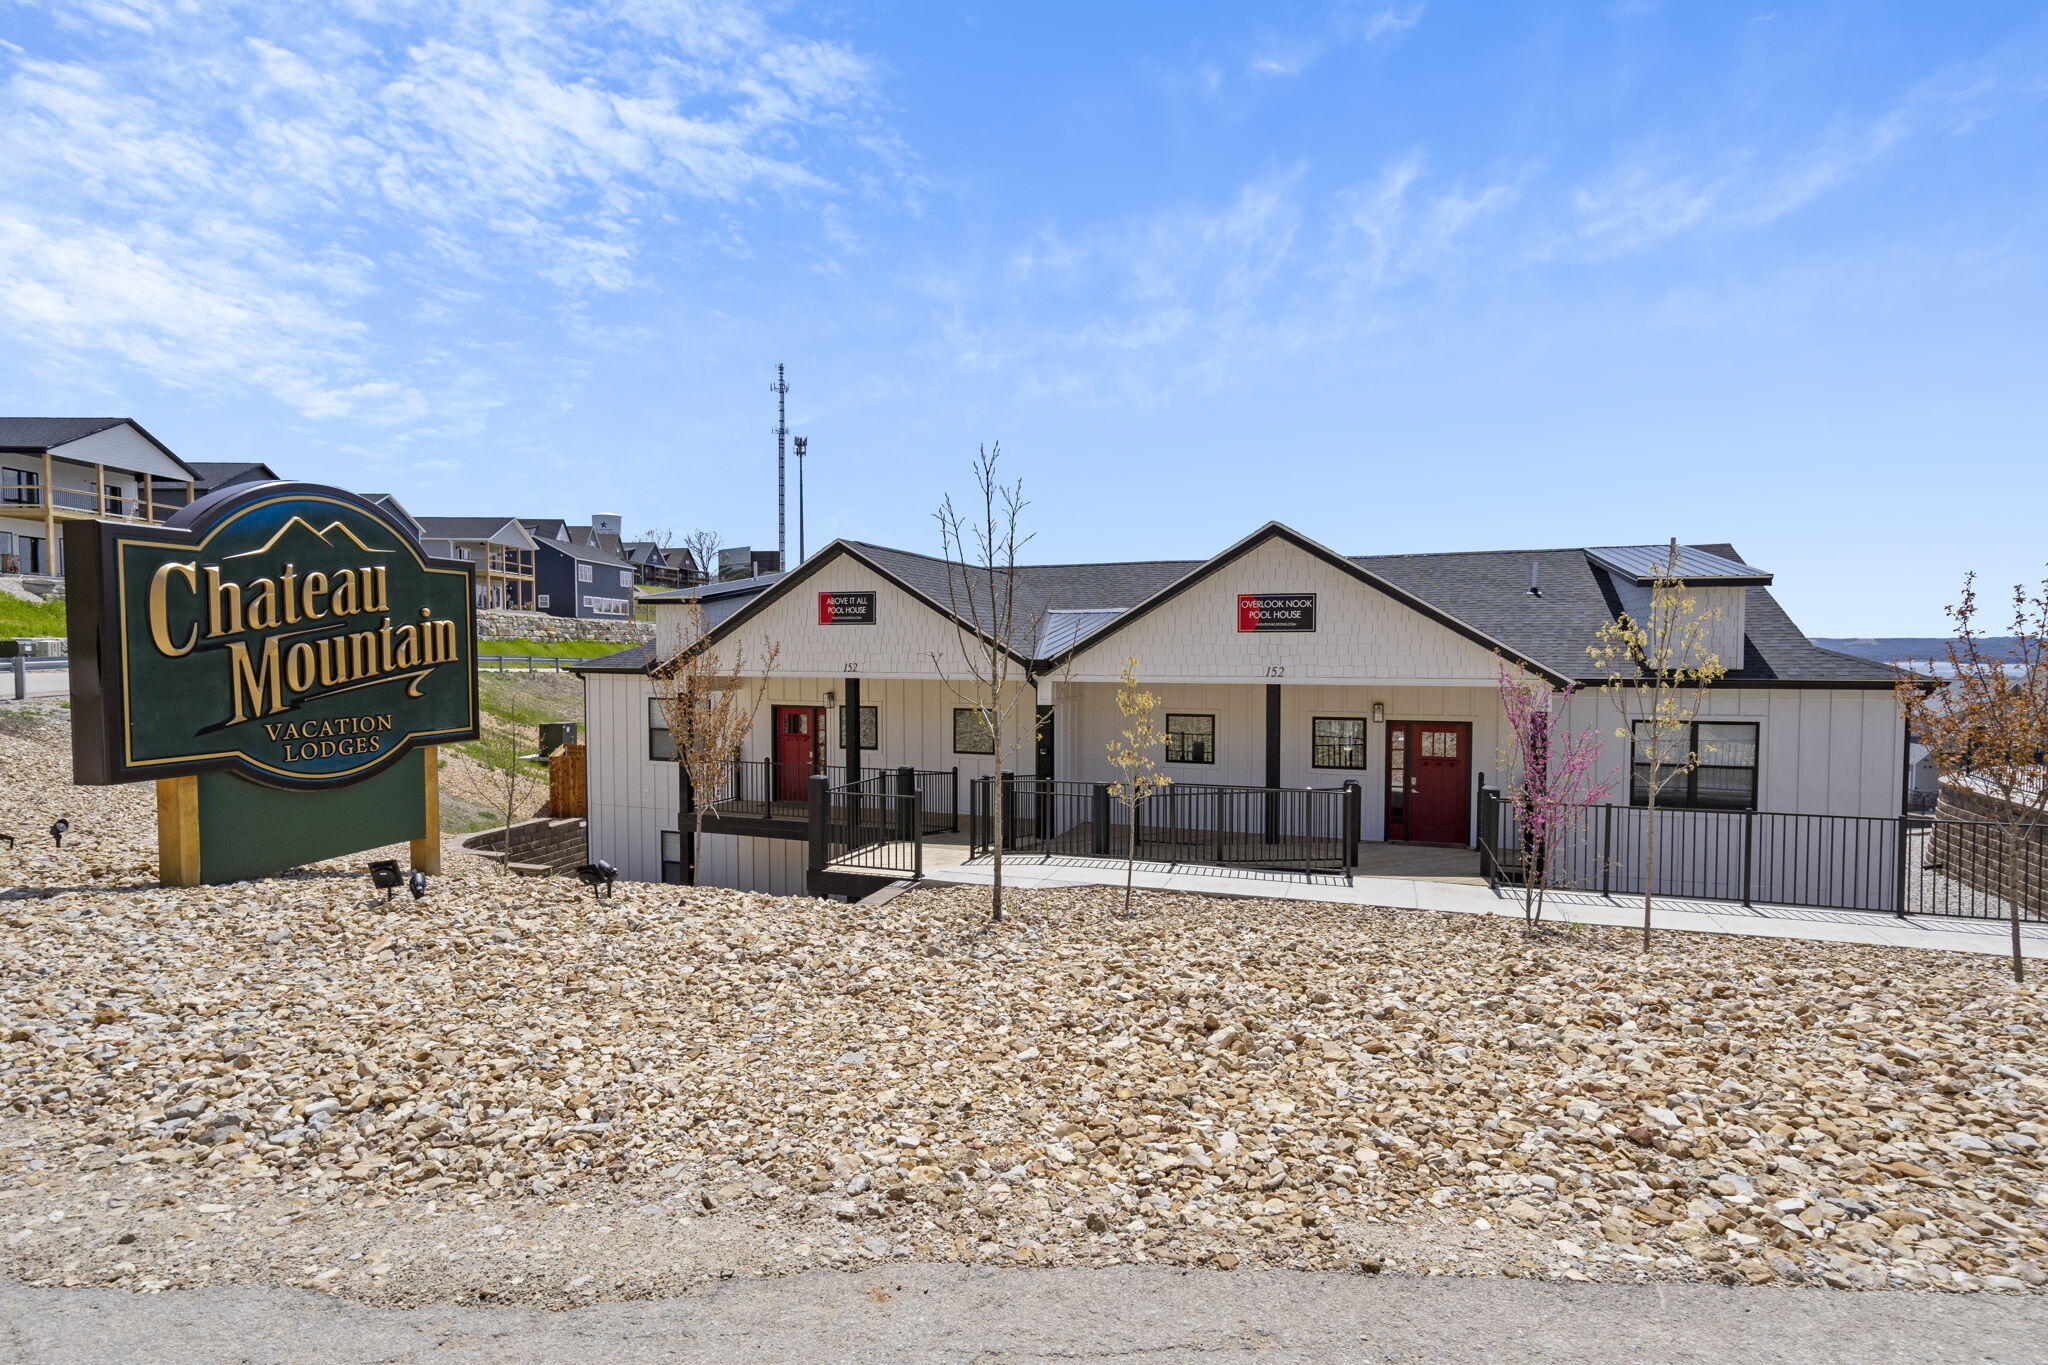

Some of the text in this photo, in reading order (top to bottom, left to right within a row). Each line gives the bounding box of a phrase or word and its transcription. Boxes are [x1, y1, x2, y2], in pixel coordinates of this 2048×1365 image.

[826, 597, 868, 605] ABOVE IT ALL
[1240, 599, 1313, 609] OVERLOOK NOOK
[148, 560, 390, 657] Chateau
[827, 606, 867, 614] POOL HOUSE
[1249, 610, 1302, 619] POOL HOUSE
[224, 606, 460, 727] Mountain
[843, 662, 858, 673] 152
[1265, 666, 1285, 678] 152
[264, 714, 393, 742] VACATION
[284, 735, 381, 763] LODGES
